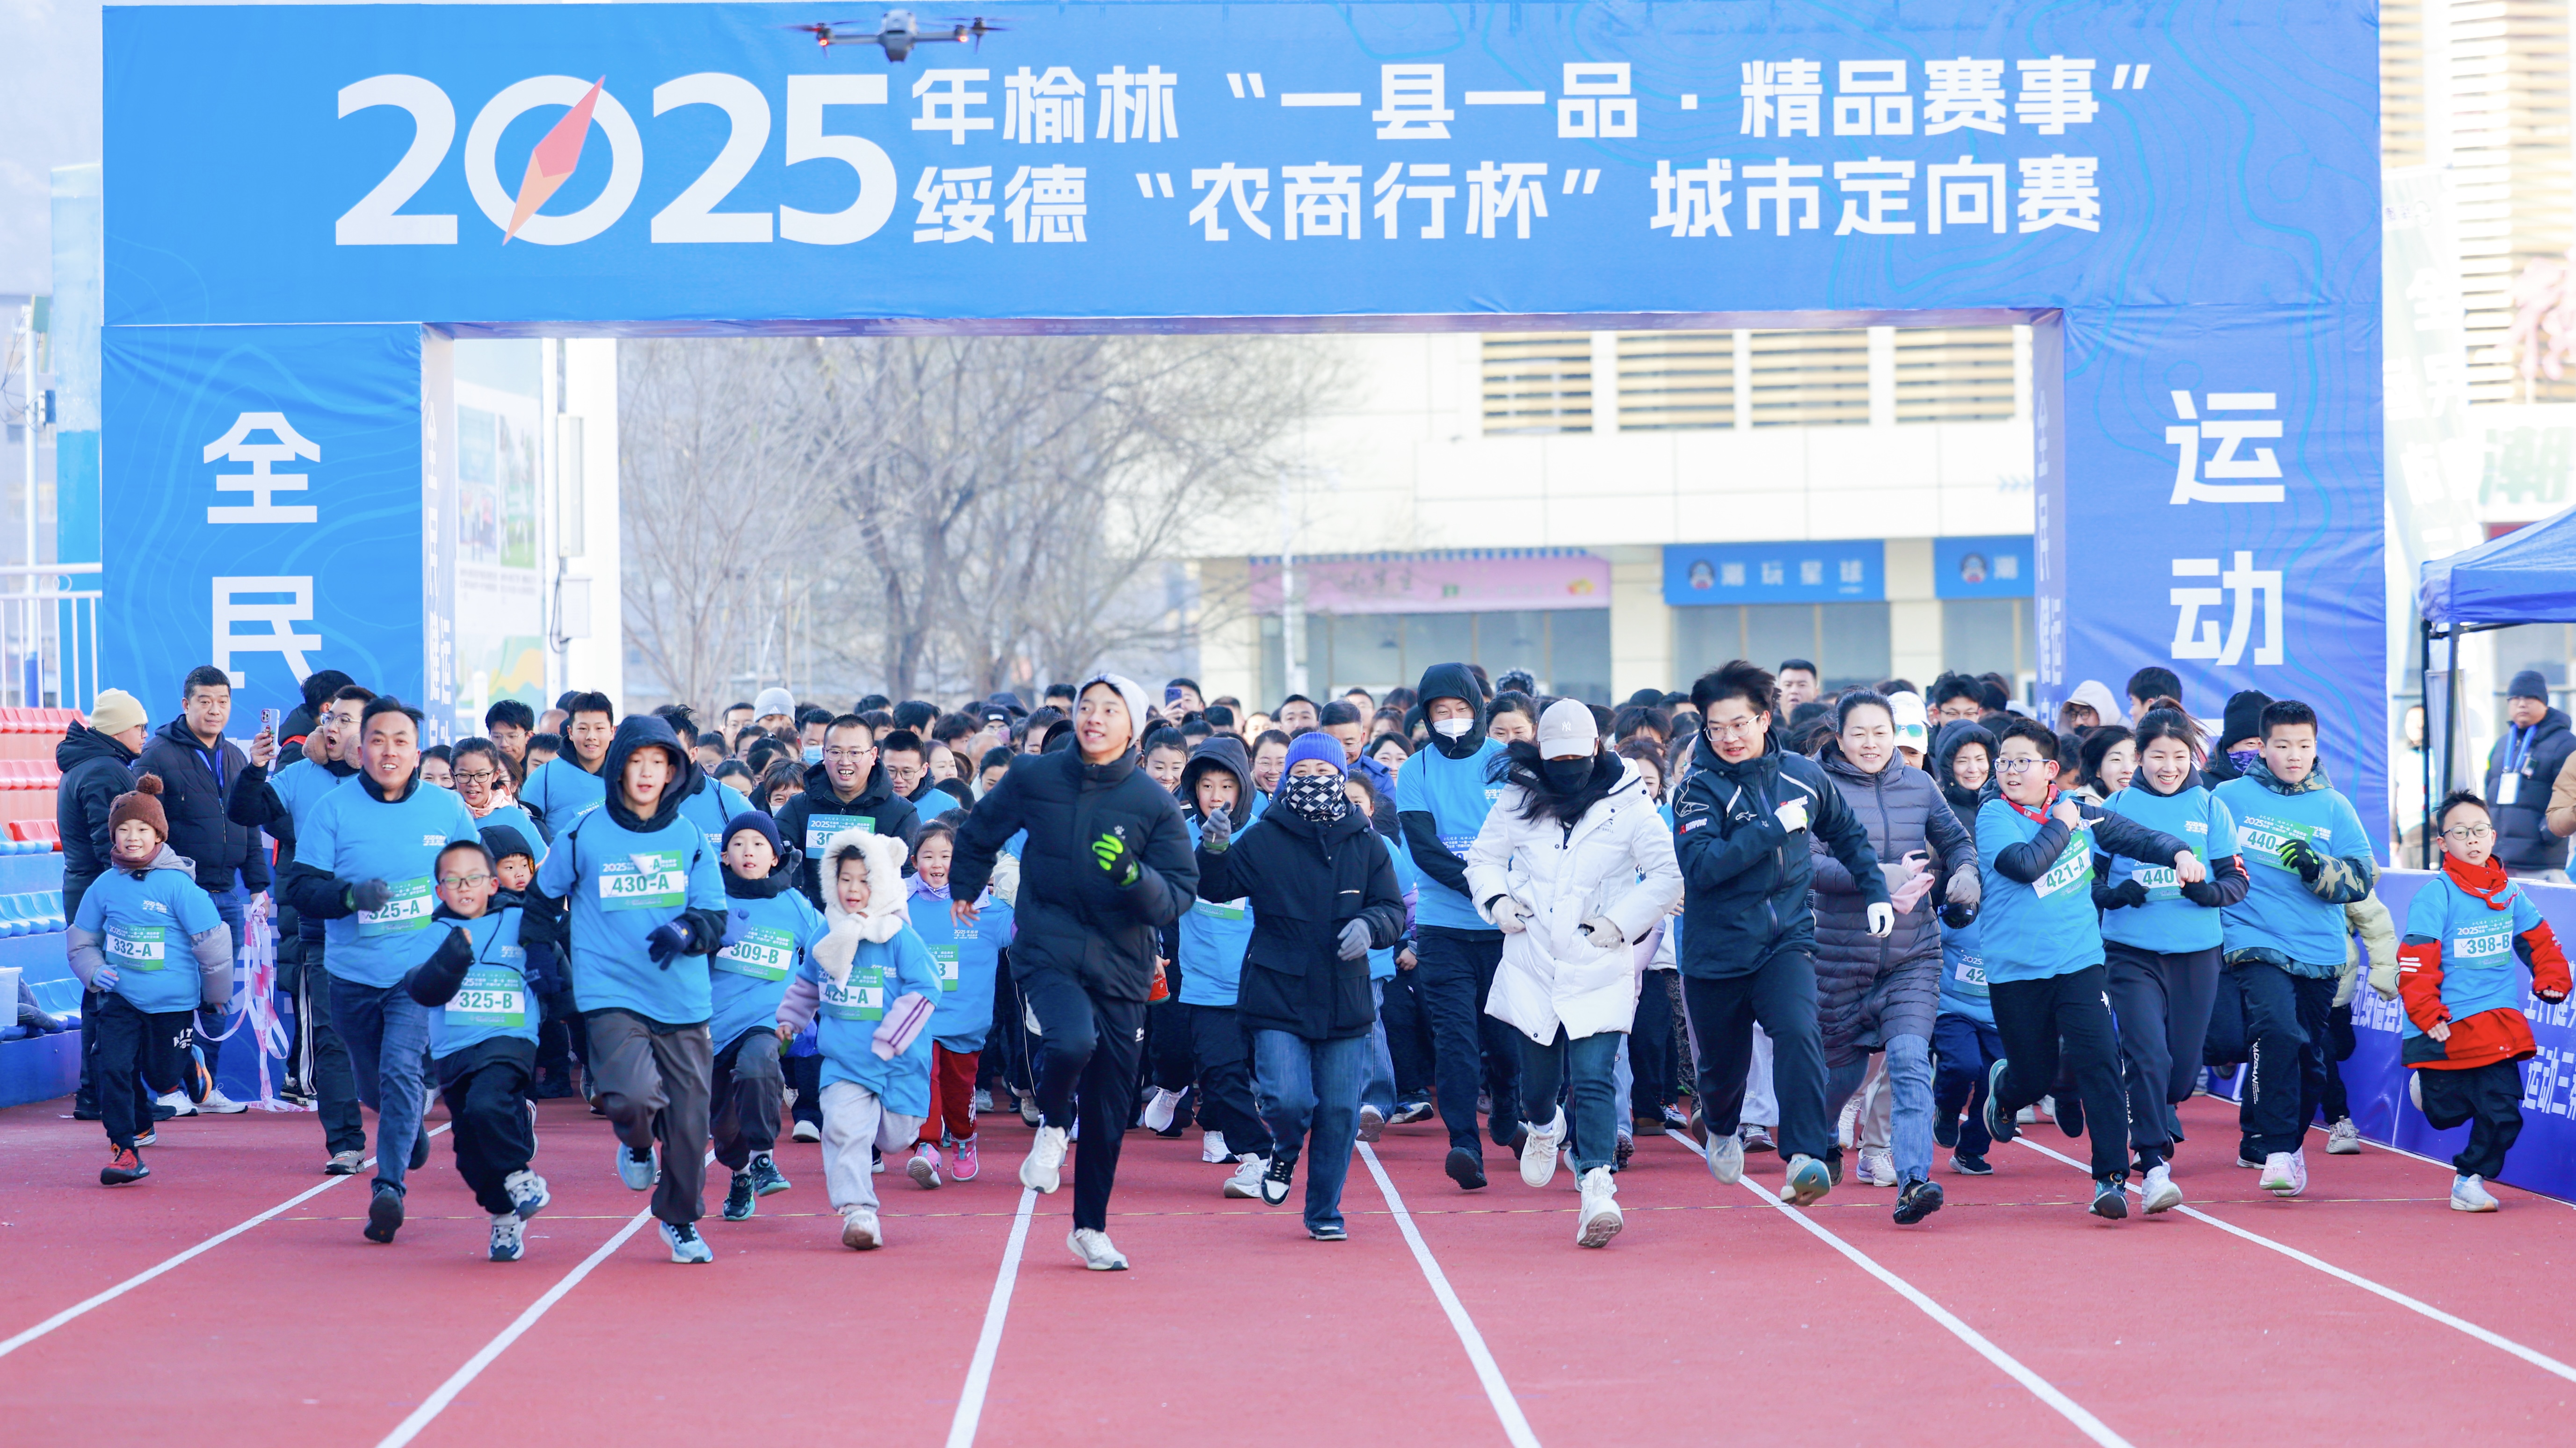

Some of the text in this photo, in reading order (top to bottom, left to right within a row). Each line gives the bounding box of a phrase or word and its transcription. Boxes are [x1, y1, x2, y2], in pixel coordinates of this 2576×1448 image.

[335, 72, 897, 246] 2025
[2243, 816, 2264, 827] 2025
[2046, 856, 2085, 888] 421-A
[612, 873, 669, 893] 430-A
[2457, 926, 2478, 935] 2025
[114, 938, 152, 957] 332-A
[730, 942, 779, 964] 309-B
[2467, 934, 2510, 954] 398-B
[1962, 954, 1982, 965] 2025
[459, 991, 513, 1009] 325-B
